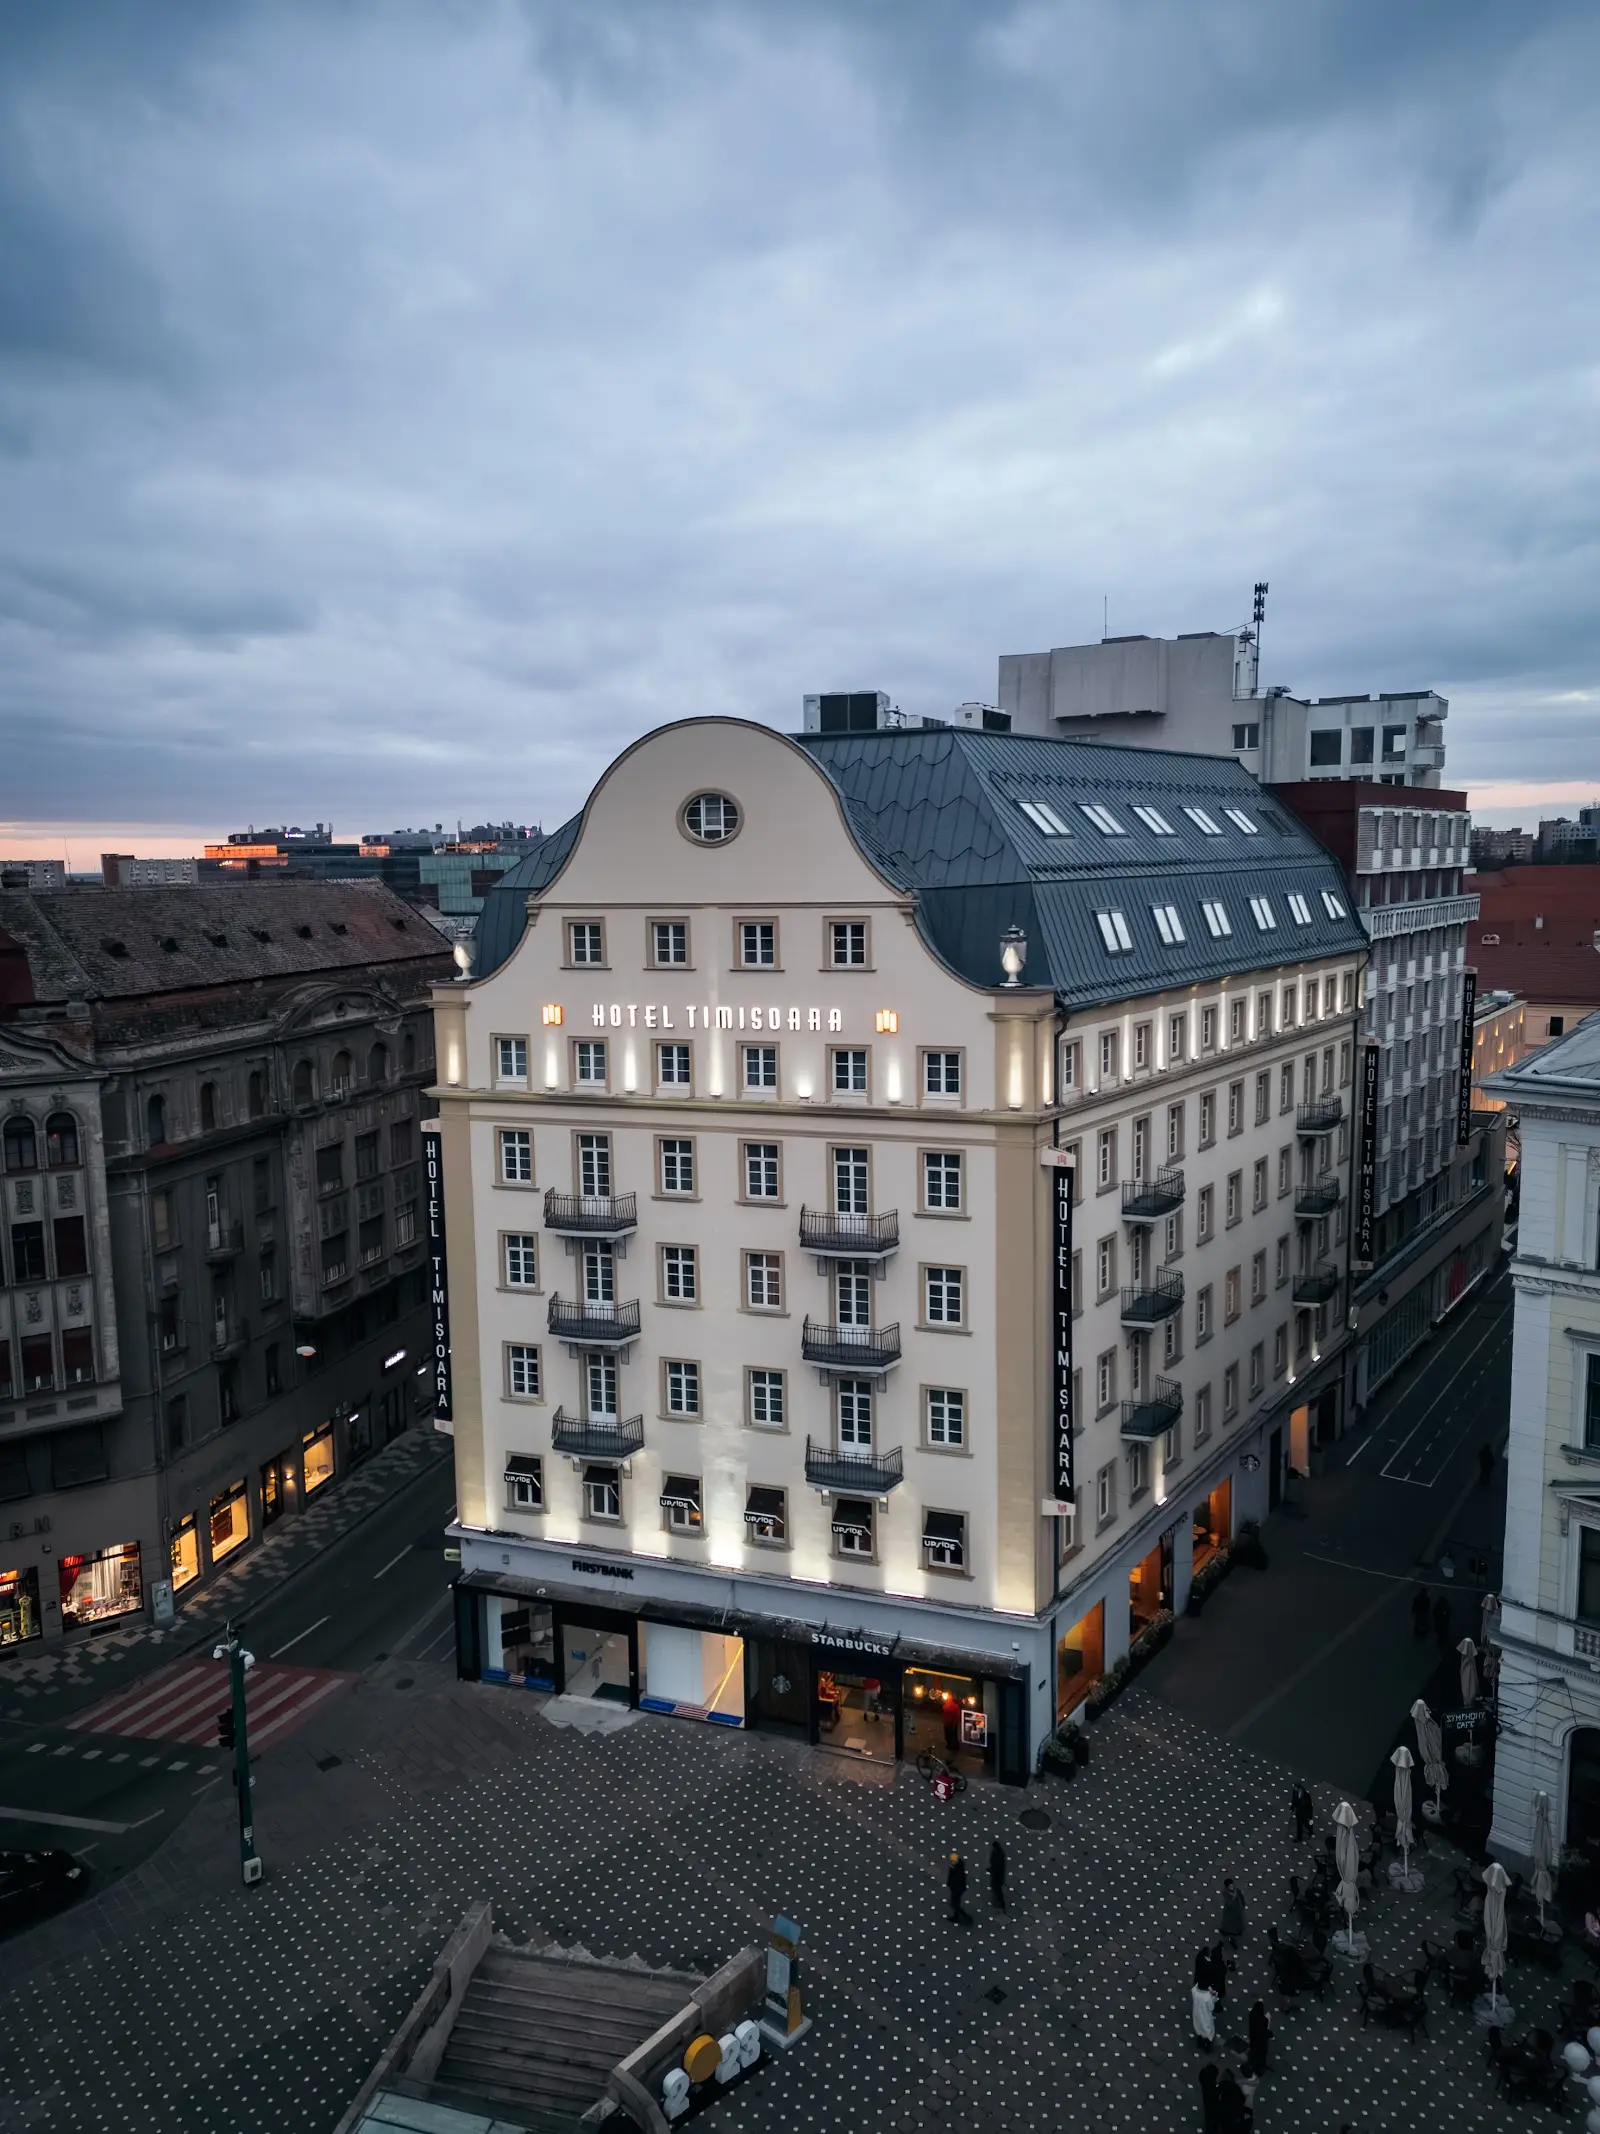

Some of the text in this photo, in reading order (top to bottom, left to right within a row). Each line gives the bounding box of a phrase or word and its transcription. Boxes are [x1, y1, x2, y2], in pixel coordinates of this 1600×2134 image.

[591, 1003, 842, 1032] HOTEL TIMISOARA
[1463, 979, 1473, 1038] HOTEL
[1365, 1053, 1376, 1126] HOTEL
[425, 1140, 440, 1238] HOTEL
[1057, 1177, 1069, 1290] HOTEL
[505, 1475, 531, 1484] UPSIDE
[661, 1499, 689, 1509] UPSIDE
[745, 1515, 774, 1526] UPSIDE
[832, 1526, 863, 1537] UPSIDE
[923, 1539, 956, 1551] UPSIDE
[811, 1633, 890, 1656] STARBUCKS
